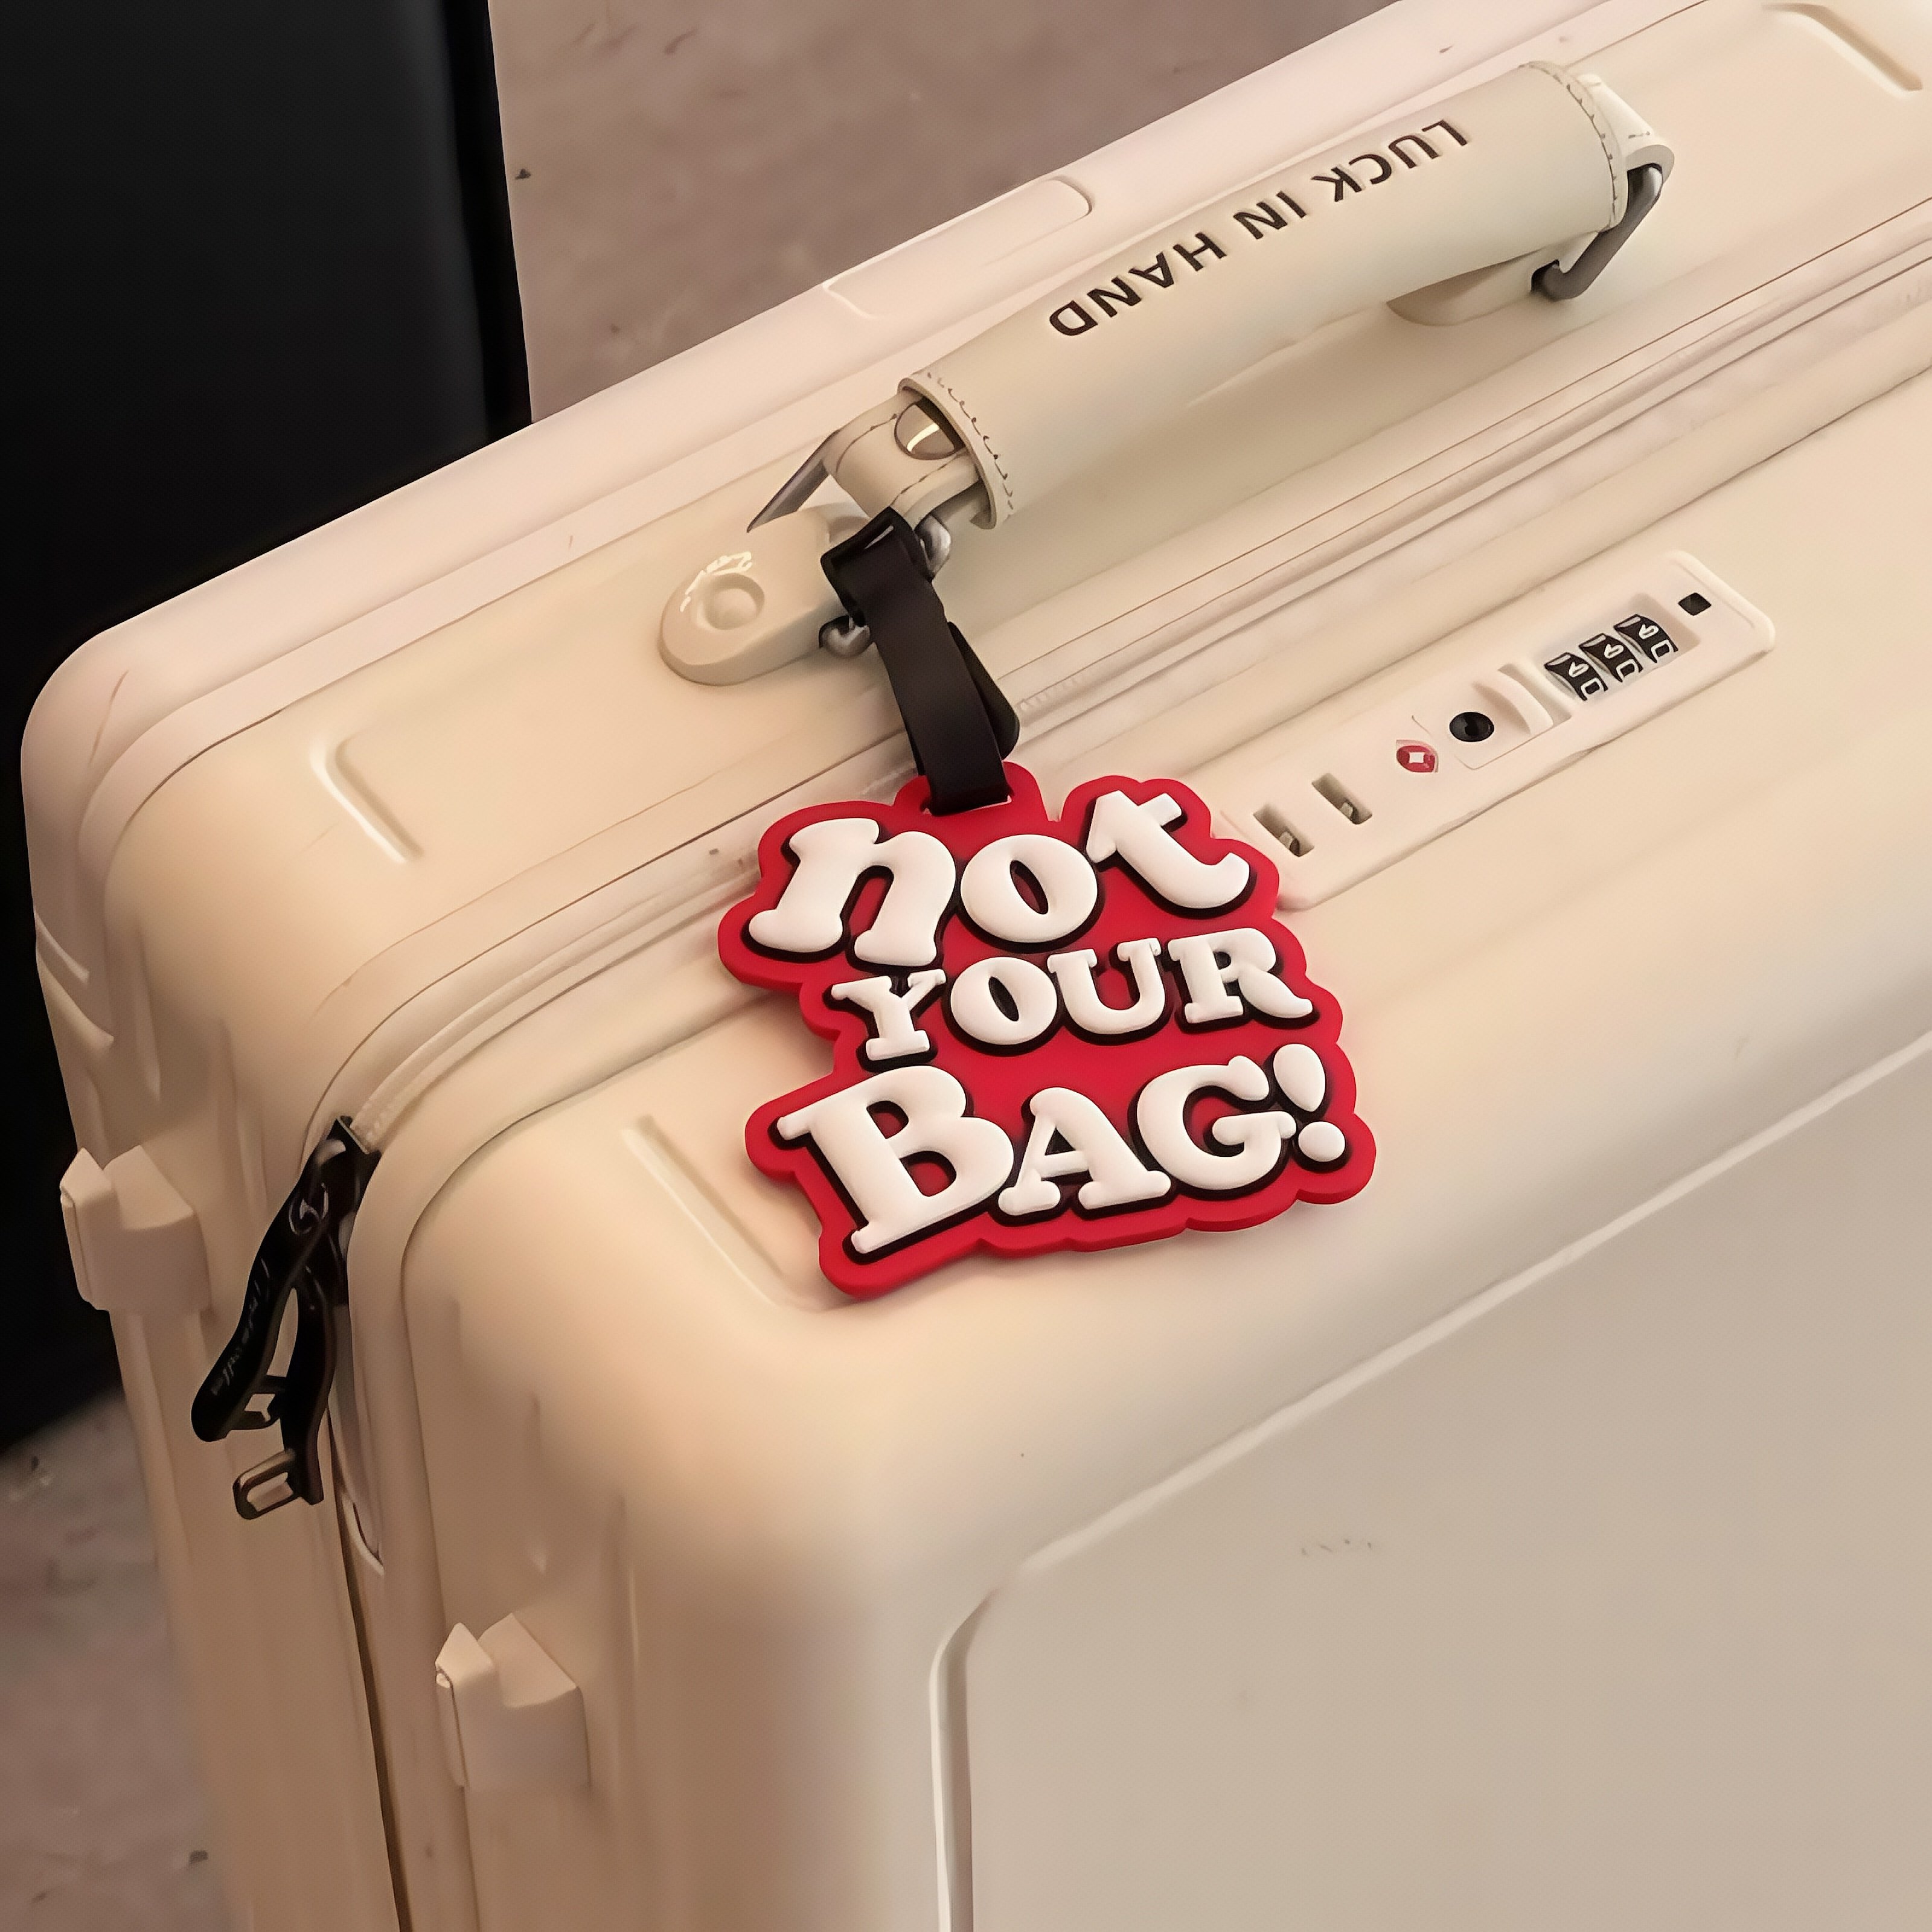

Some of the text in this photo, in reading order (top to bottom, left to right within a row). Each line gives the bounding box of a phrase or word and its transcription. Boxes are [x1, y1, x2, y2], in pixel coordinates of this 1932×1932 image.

[1048, 119, 1469, 337] LUCK IN HAND
[747, 789, 1250, 967] not
[830, 927, 1314, 1061] YOUR
[776, 1043, 1347, 1255] BAG!
